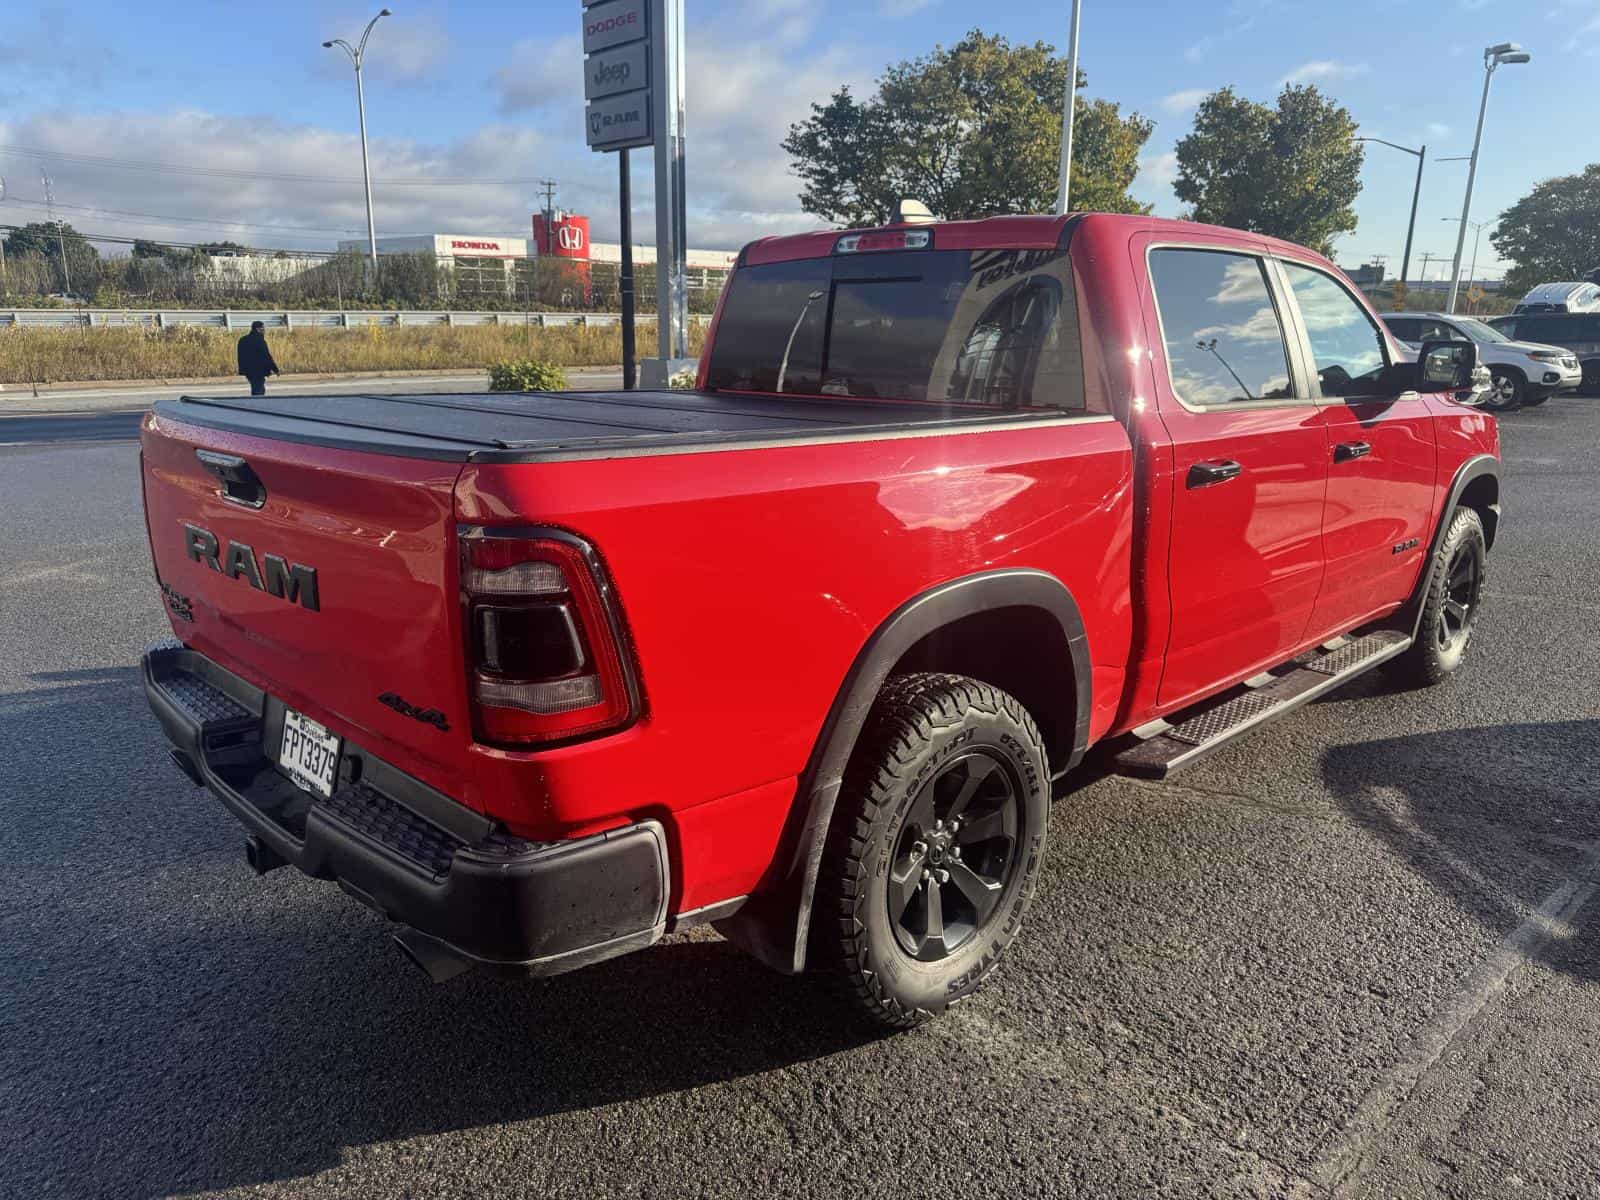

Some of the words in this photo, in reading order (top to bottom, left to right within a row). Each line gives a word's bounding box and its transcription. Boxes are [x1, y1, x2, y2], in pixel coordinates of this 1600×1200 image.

[586, 11, 636, 36] DODGE
[594, 60, 630, 85] Jeep
[602, 110, 640, 127] RAM
[451, 240, 500, 250] HONDA
[184, 522, 321, 613] RAM
[282, 724, 337, 785] FPT3379
